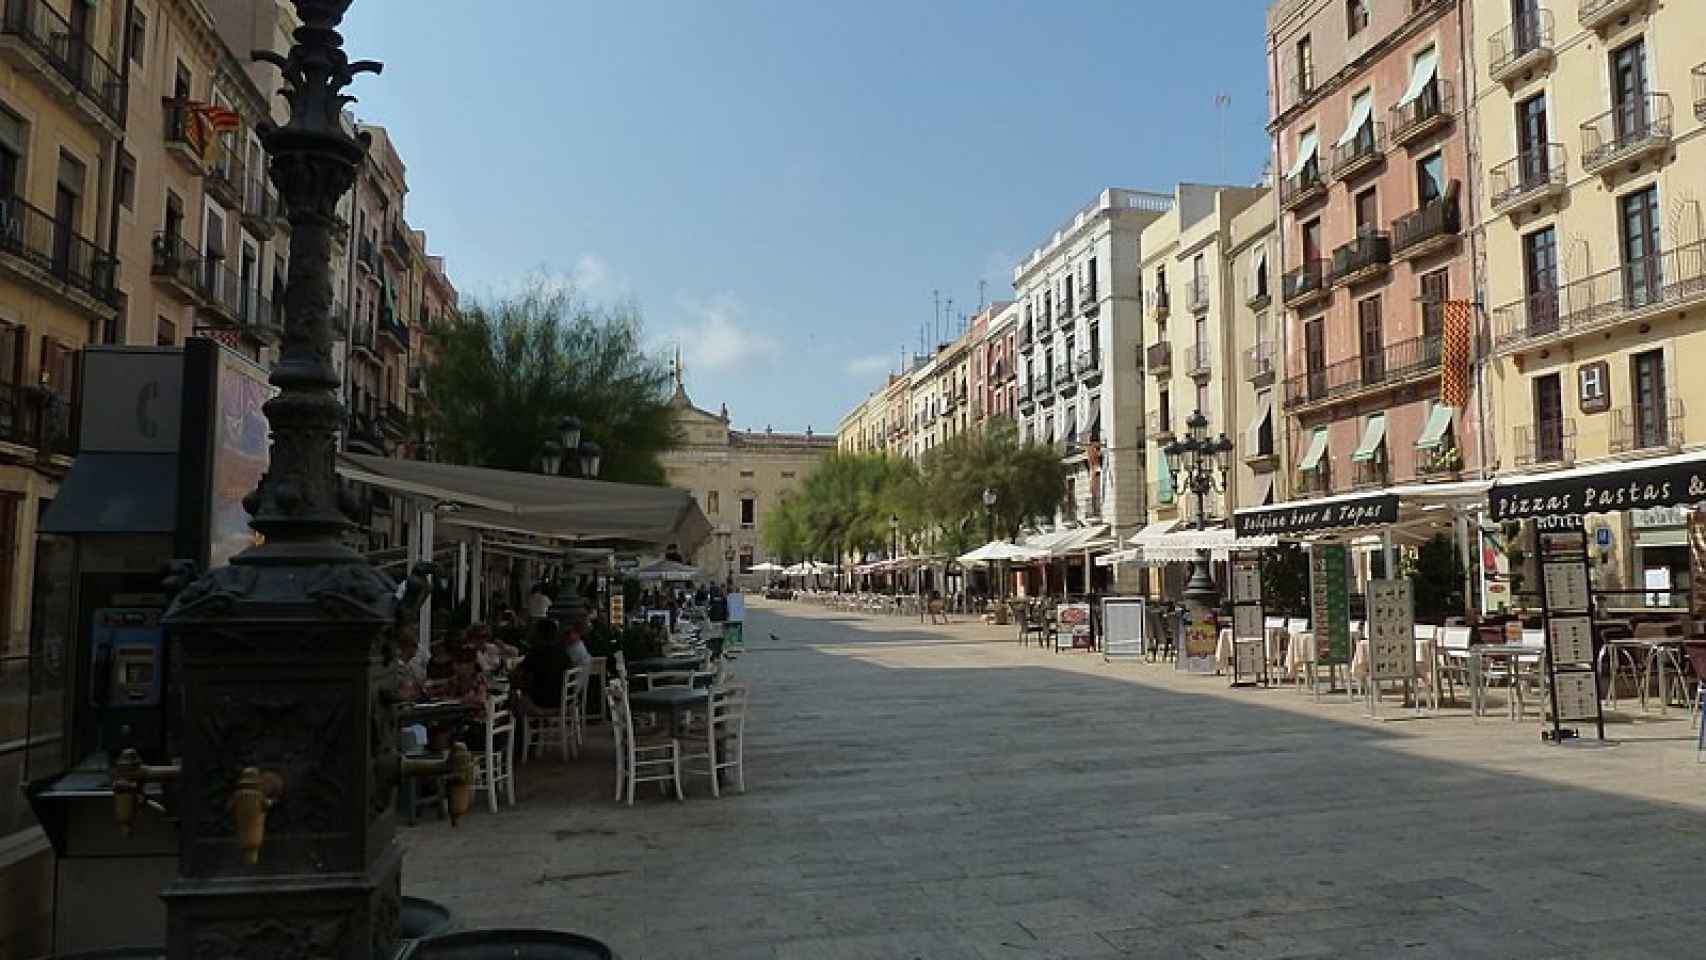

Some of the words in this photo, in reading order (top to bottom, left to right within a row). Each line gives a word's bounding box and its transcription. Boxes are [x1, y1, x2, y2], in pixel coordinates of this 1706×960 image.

[1584, 482, 1671, 506] Pastas
[1339, 504, 1382, 526] Tapas
[1537, 514, 1583, 528] HOTEL
